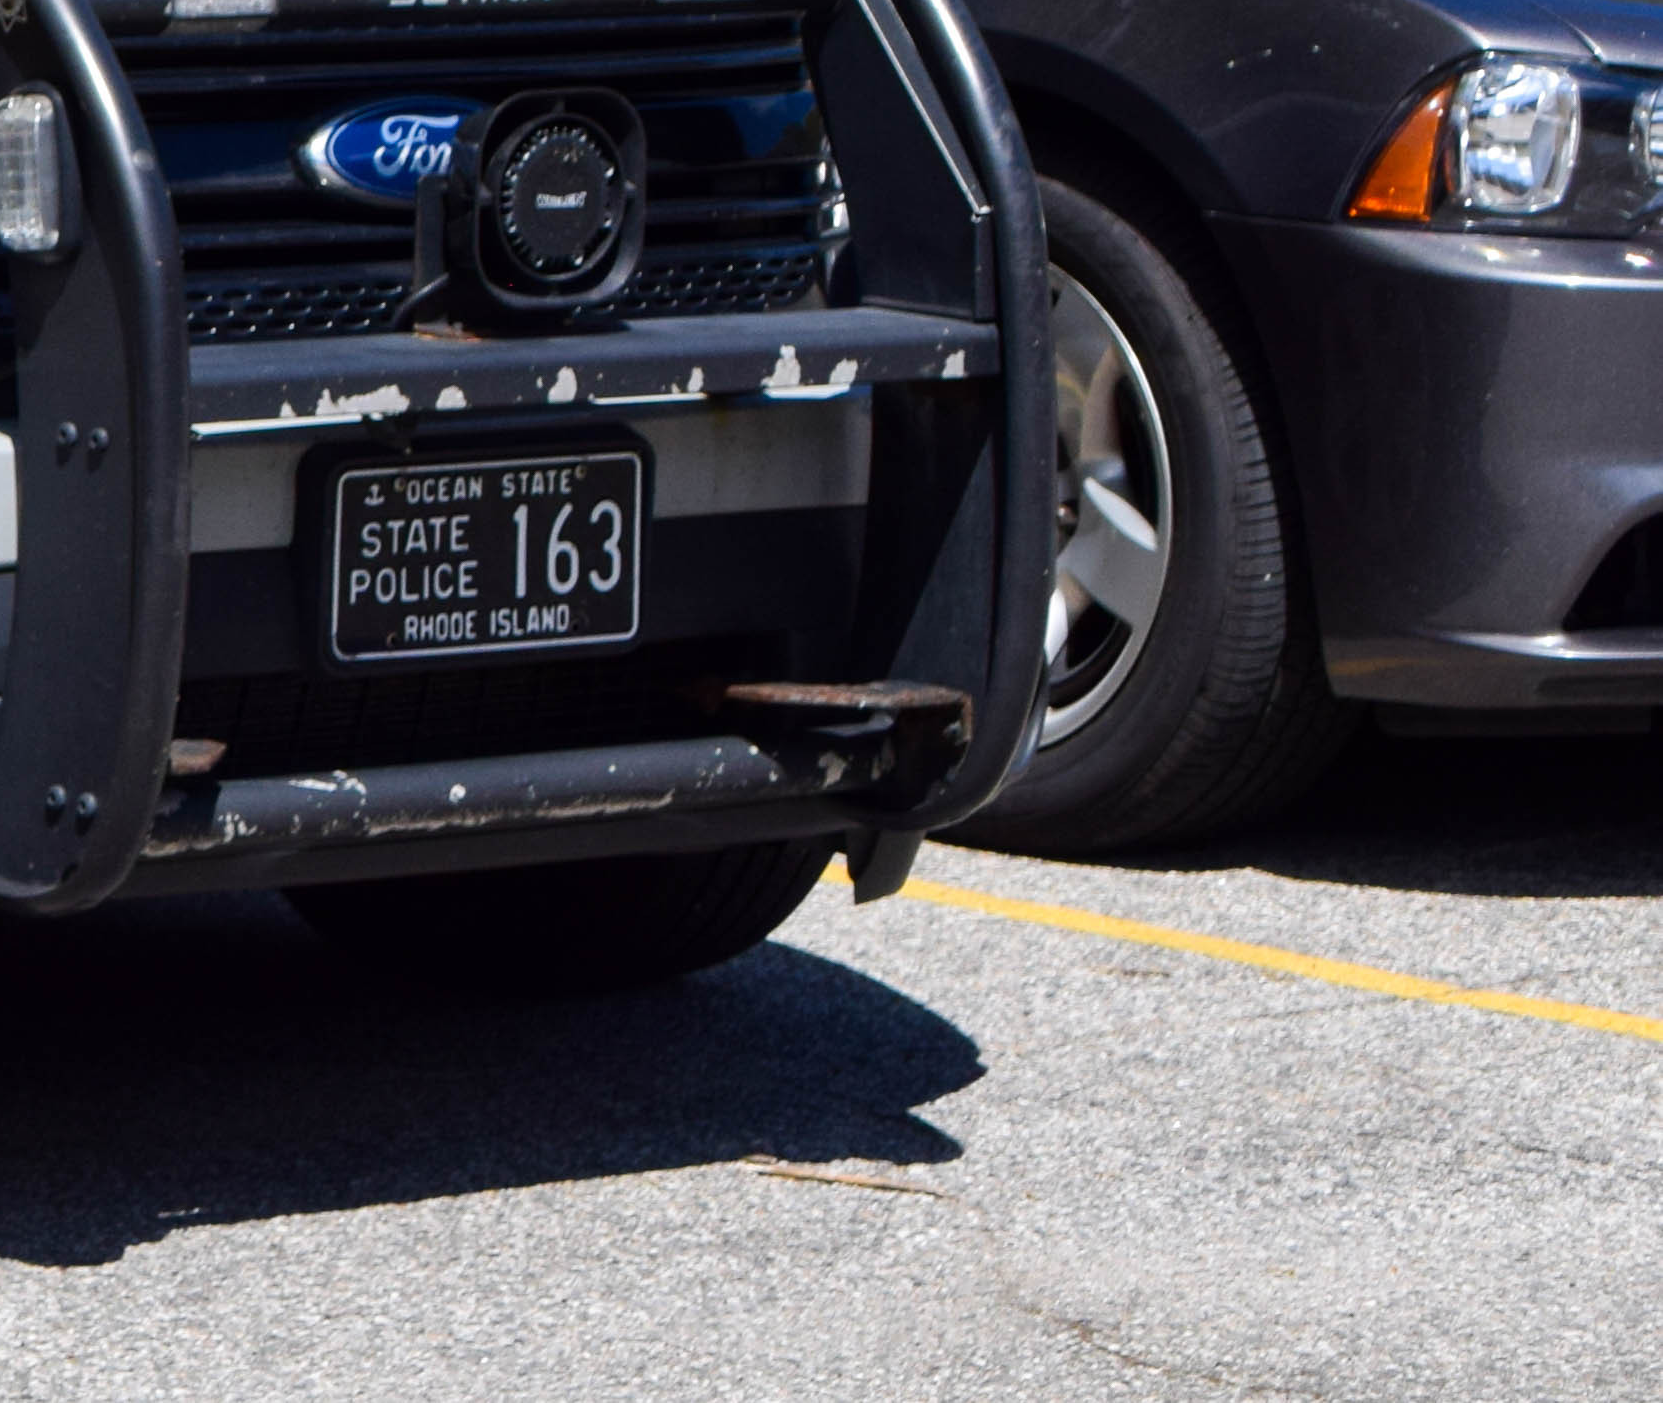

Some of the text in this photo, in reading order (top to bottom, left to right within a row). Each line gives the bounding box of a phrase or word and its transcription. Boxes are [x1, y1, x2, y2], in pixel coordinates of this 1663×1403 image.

[405, 469, 574, 505] OCEAN STATE
[360, 515, 471, 558] STATE
[512, 499, 623, 598] 163
[348, 560, 479, 604] POLICE
[403, 604, 570, 642] RHODE ISLAND
